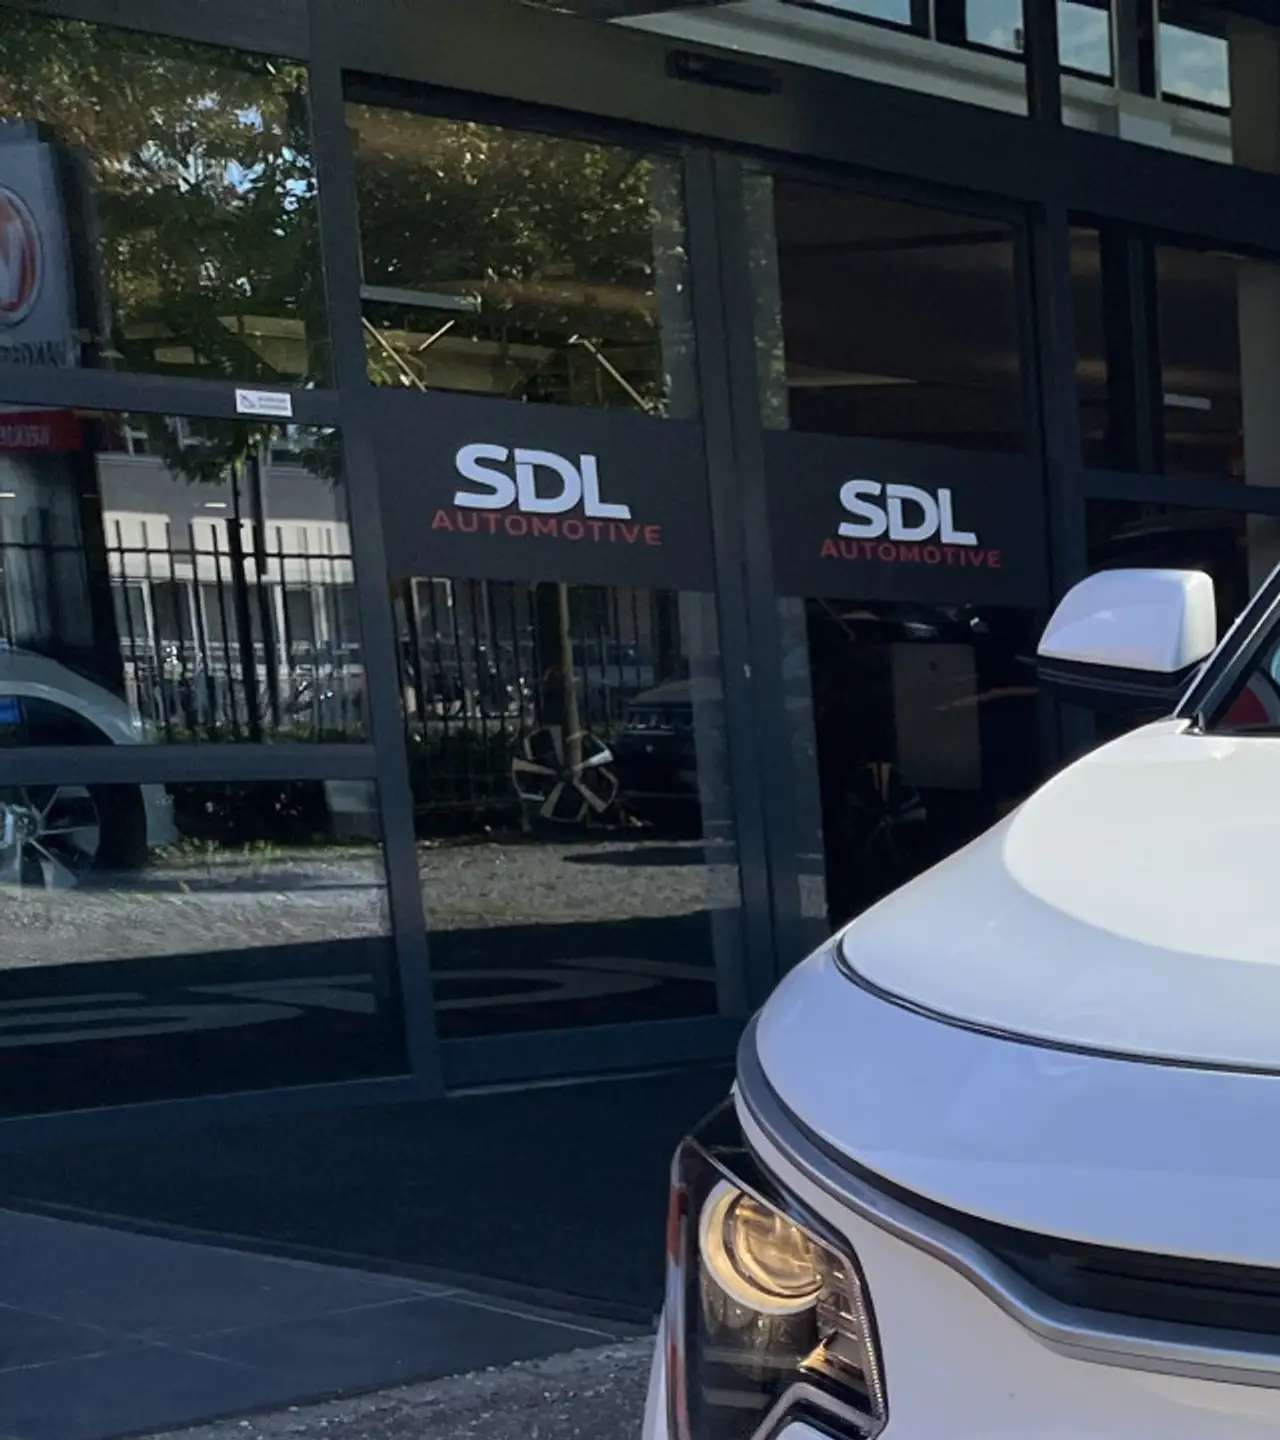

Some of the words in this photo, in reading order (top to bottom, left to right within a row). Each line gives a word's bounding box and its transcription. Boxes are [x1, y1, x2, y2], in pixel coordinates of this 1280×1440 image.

[454, 443, 632, 520] SDL
[432, 509, 662, 546] AUTOMOTIVE
[838, 479, 978, 545] SDL
[820, 538, 1002, 569] AUTOMOTIVE
